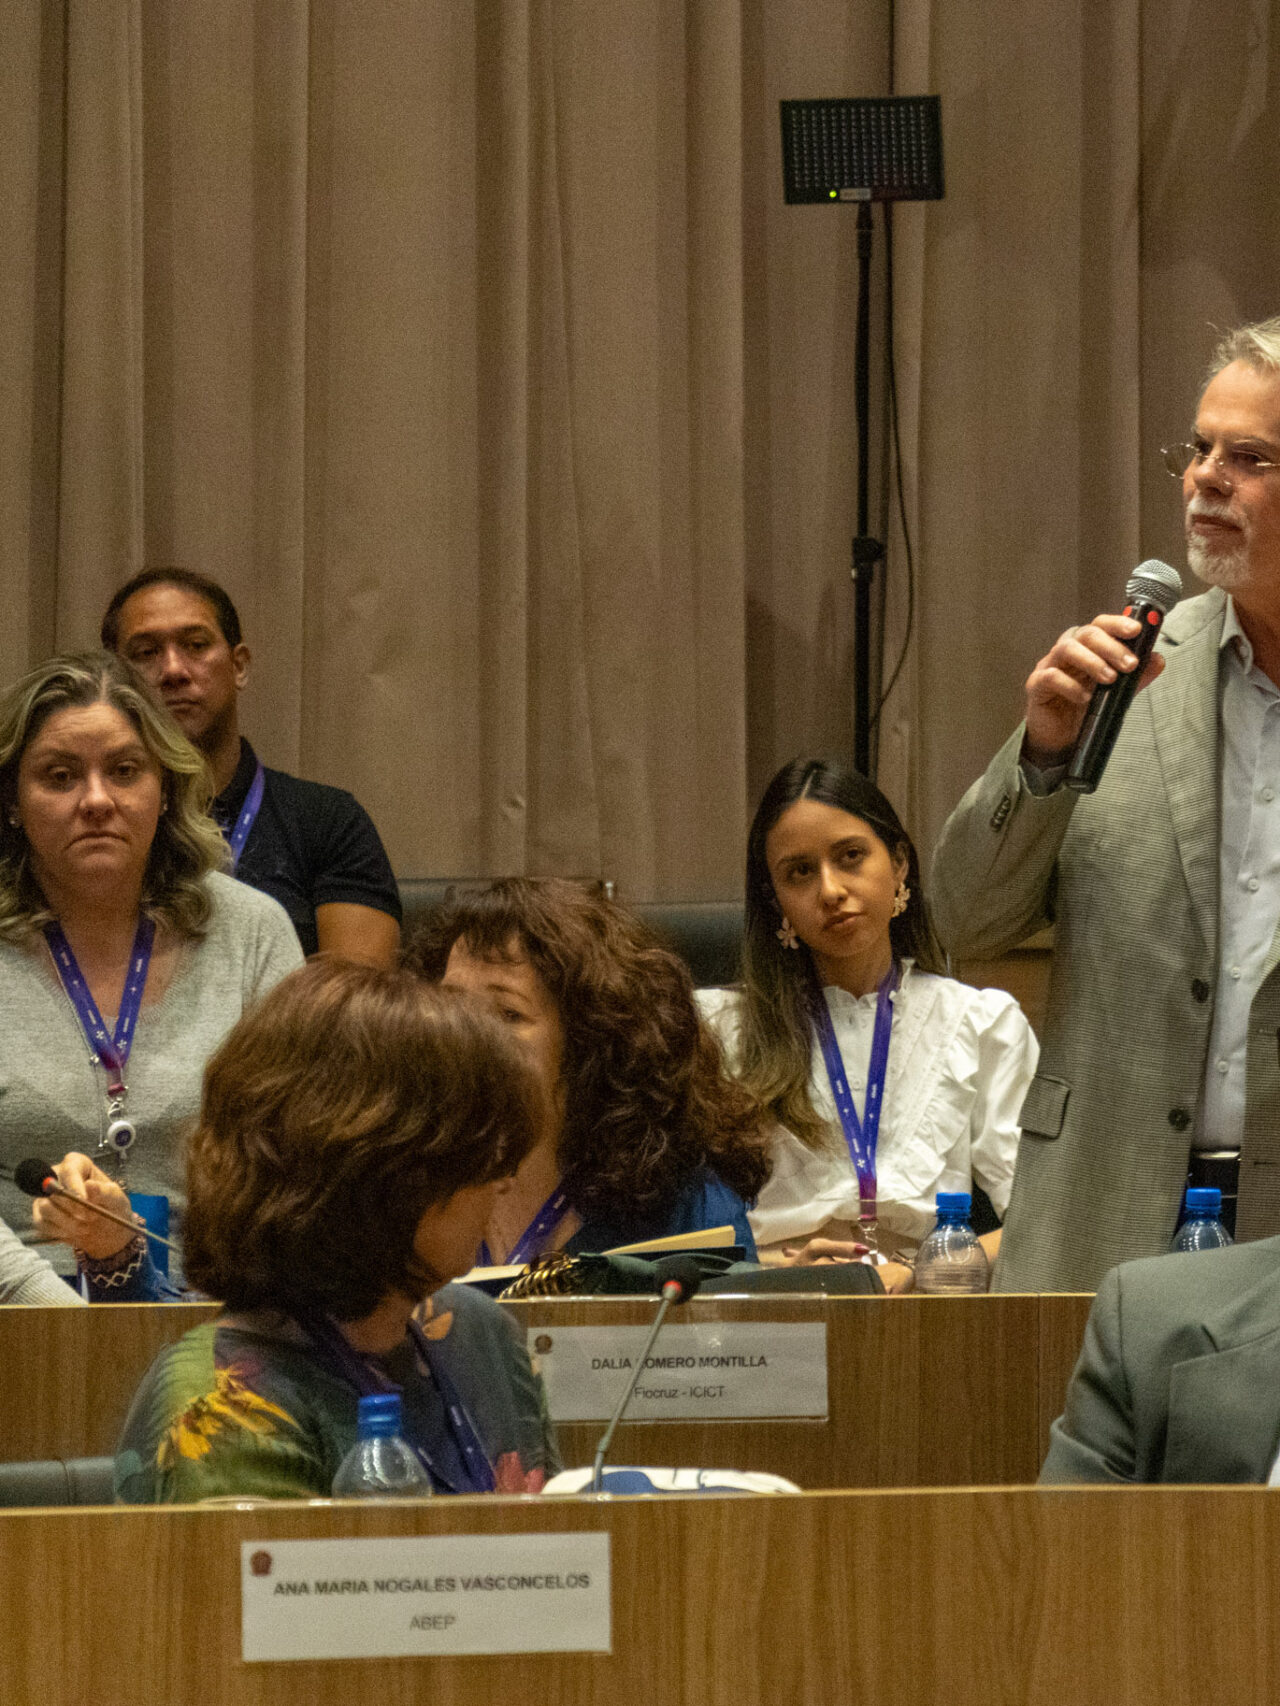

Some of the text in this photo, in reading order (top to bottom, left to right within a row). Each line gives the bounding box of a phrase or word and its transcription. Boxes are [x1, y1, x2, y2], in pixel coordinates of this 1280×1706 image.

[591, 1356, 767, 1370] DALIA OMERO MONTILLA
[634, 1387, 678, 1399] Fiocruz
[689, 1386, 725, 1398] ICICT
[273, 1573, 590, 1596] ANA MARIA NOGALES VASCONCELOS
[409, 1615, 456, 1631] ABEP
